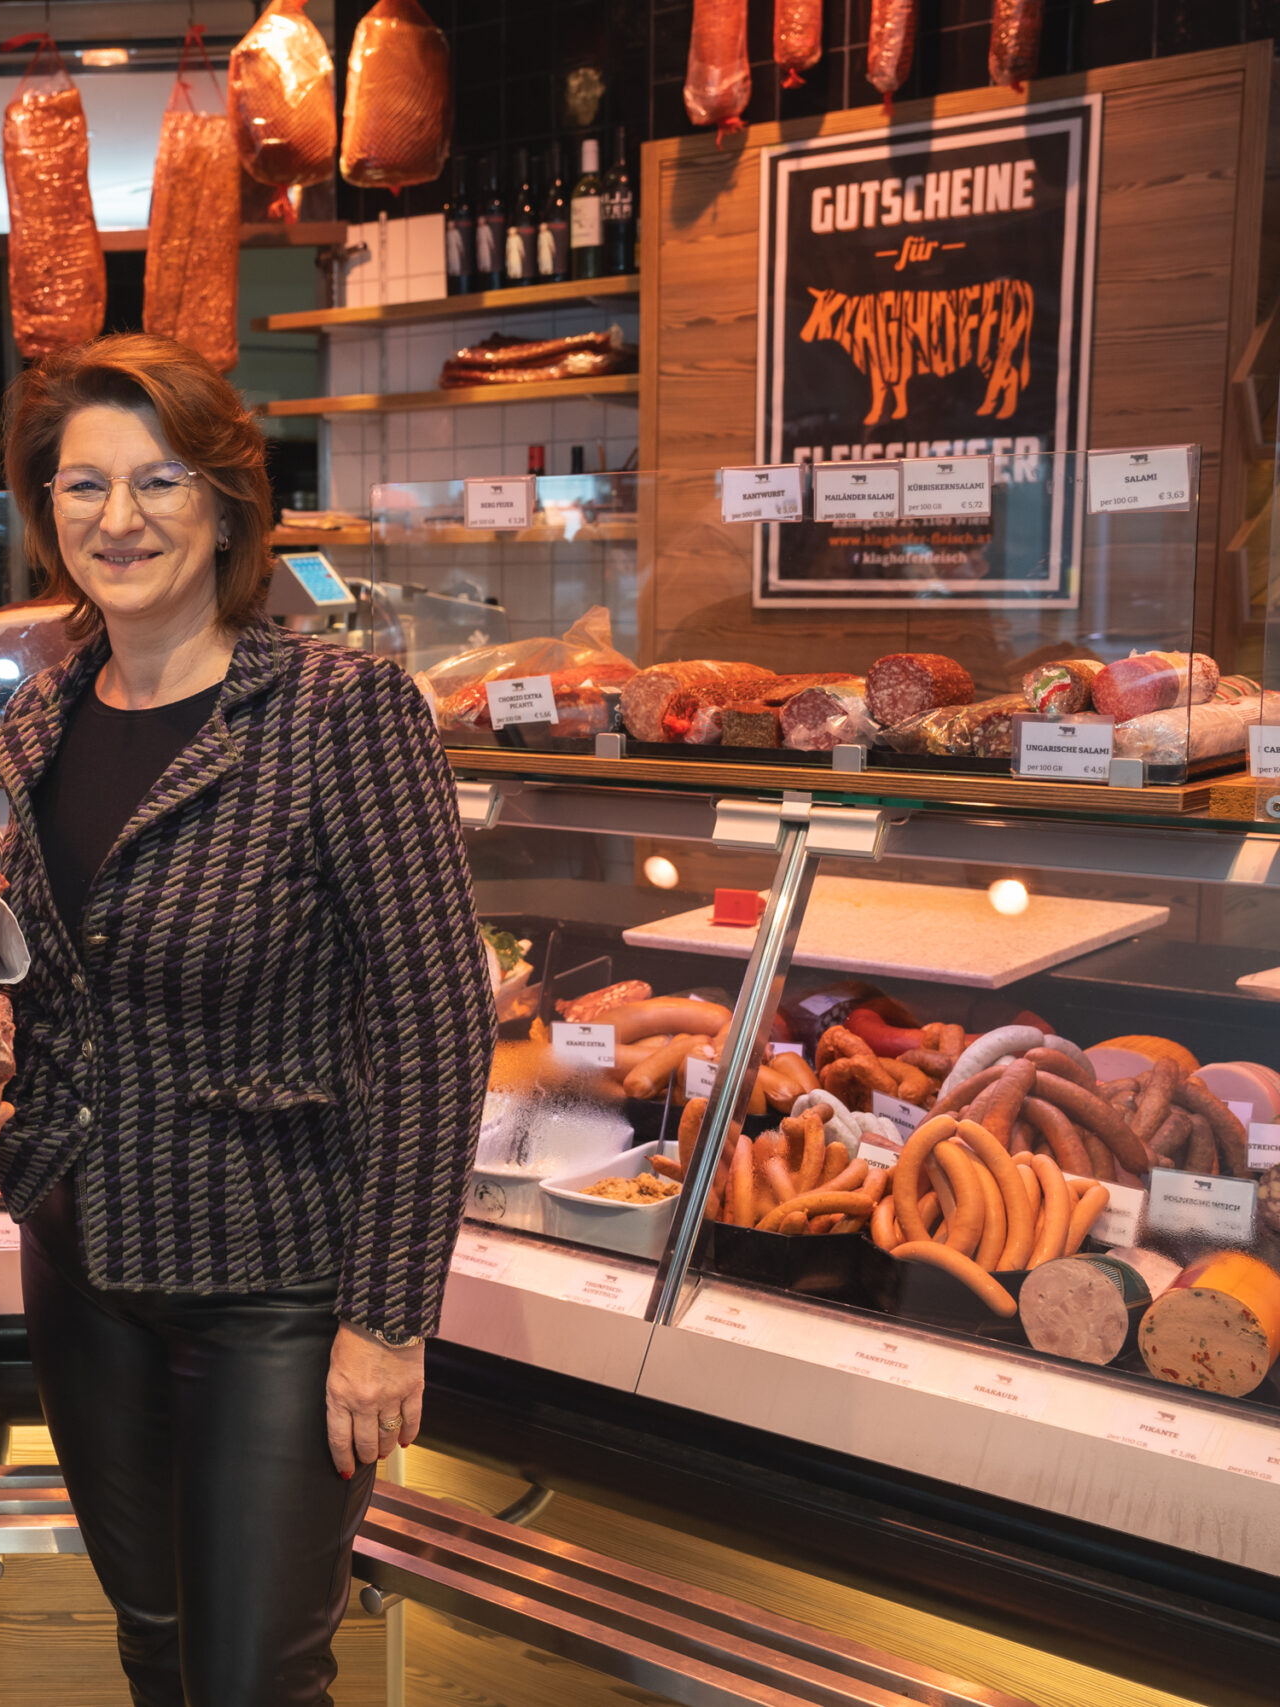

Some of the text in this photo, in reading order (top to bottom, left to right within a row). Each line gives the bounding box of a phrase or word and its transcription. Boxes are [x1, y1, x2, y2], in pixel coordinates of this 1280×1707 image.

[811, 159, 1035, 234] GUTSCHEINE
[894, 236, 939, 272] für
[1124, 473, 1158, 484] SALAMI
[907, 482, 985, 492] KÜRBISKERNSALAMI
[742, 489, 786, 500] KANTWURST
[824, 493, 867, 501] MAILÄNDER
[1025, 744, 1109, 755] UNGARISCHE SALAMI
[973, 1384, 1019, 1402] KRAKAUER
[1139, 1423, 1180, 1440] PIKANTE
